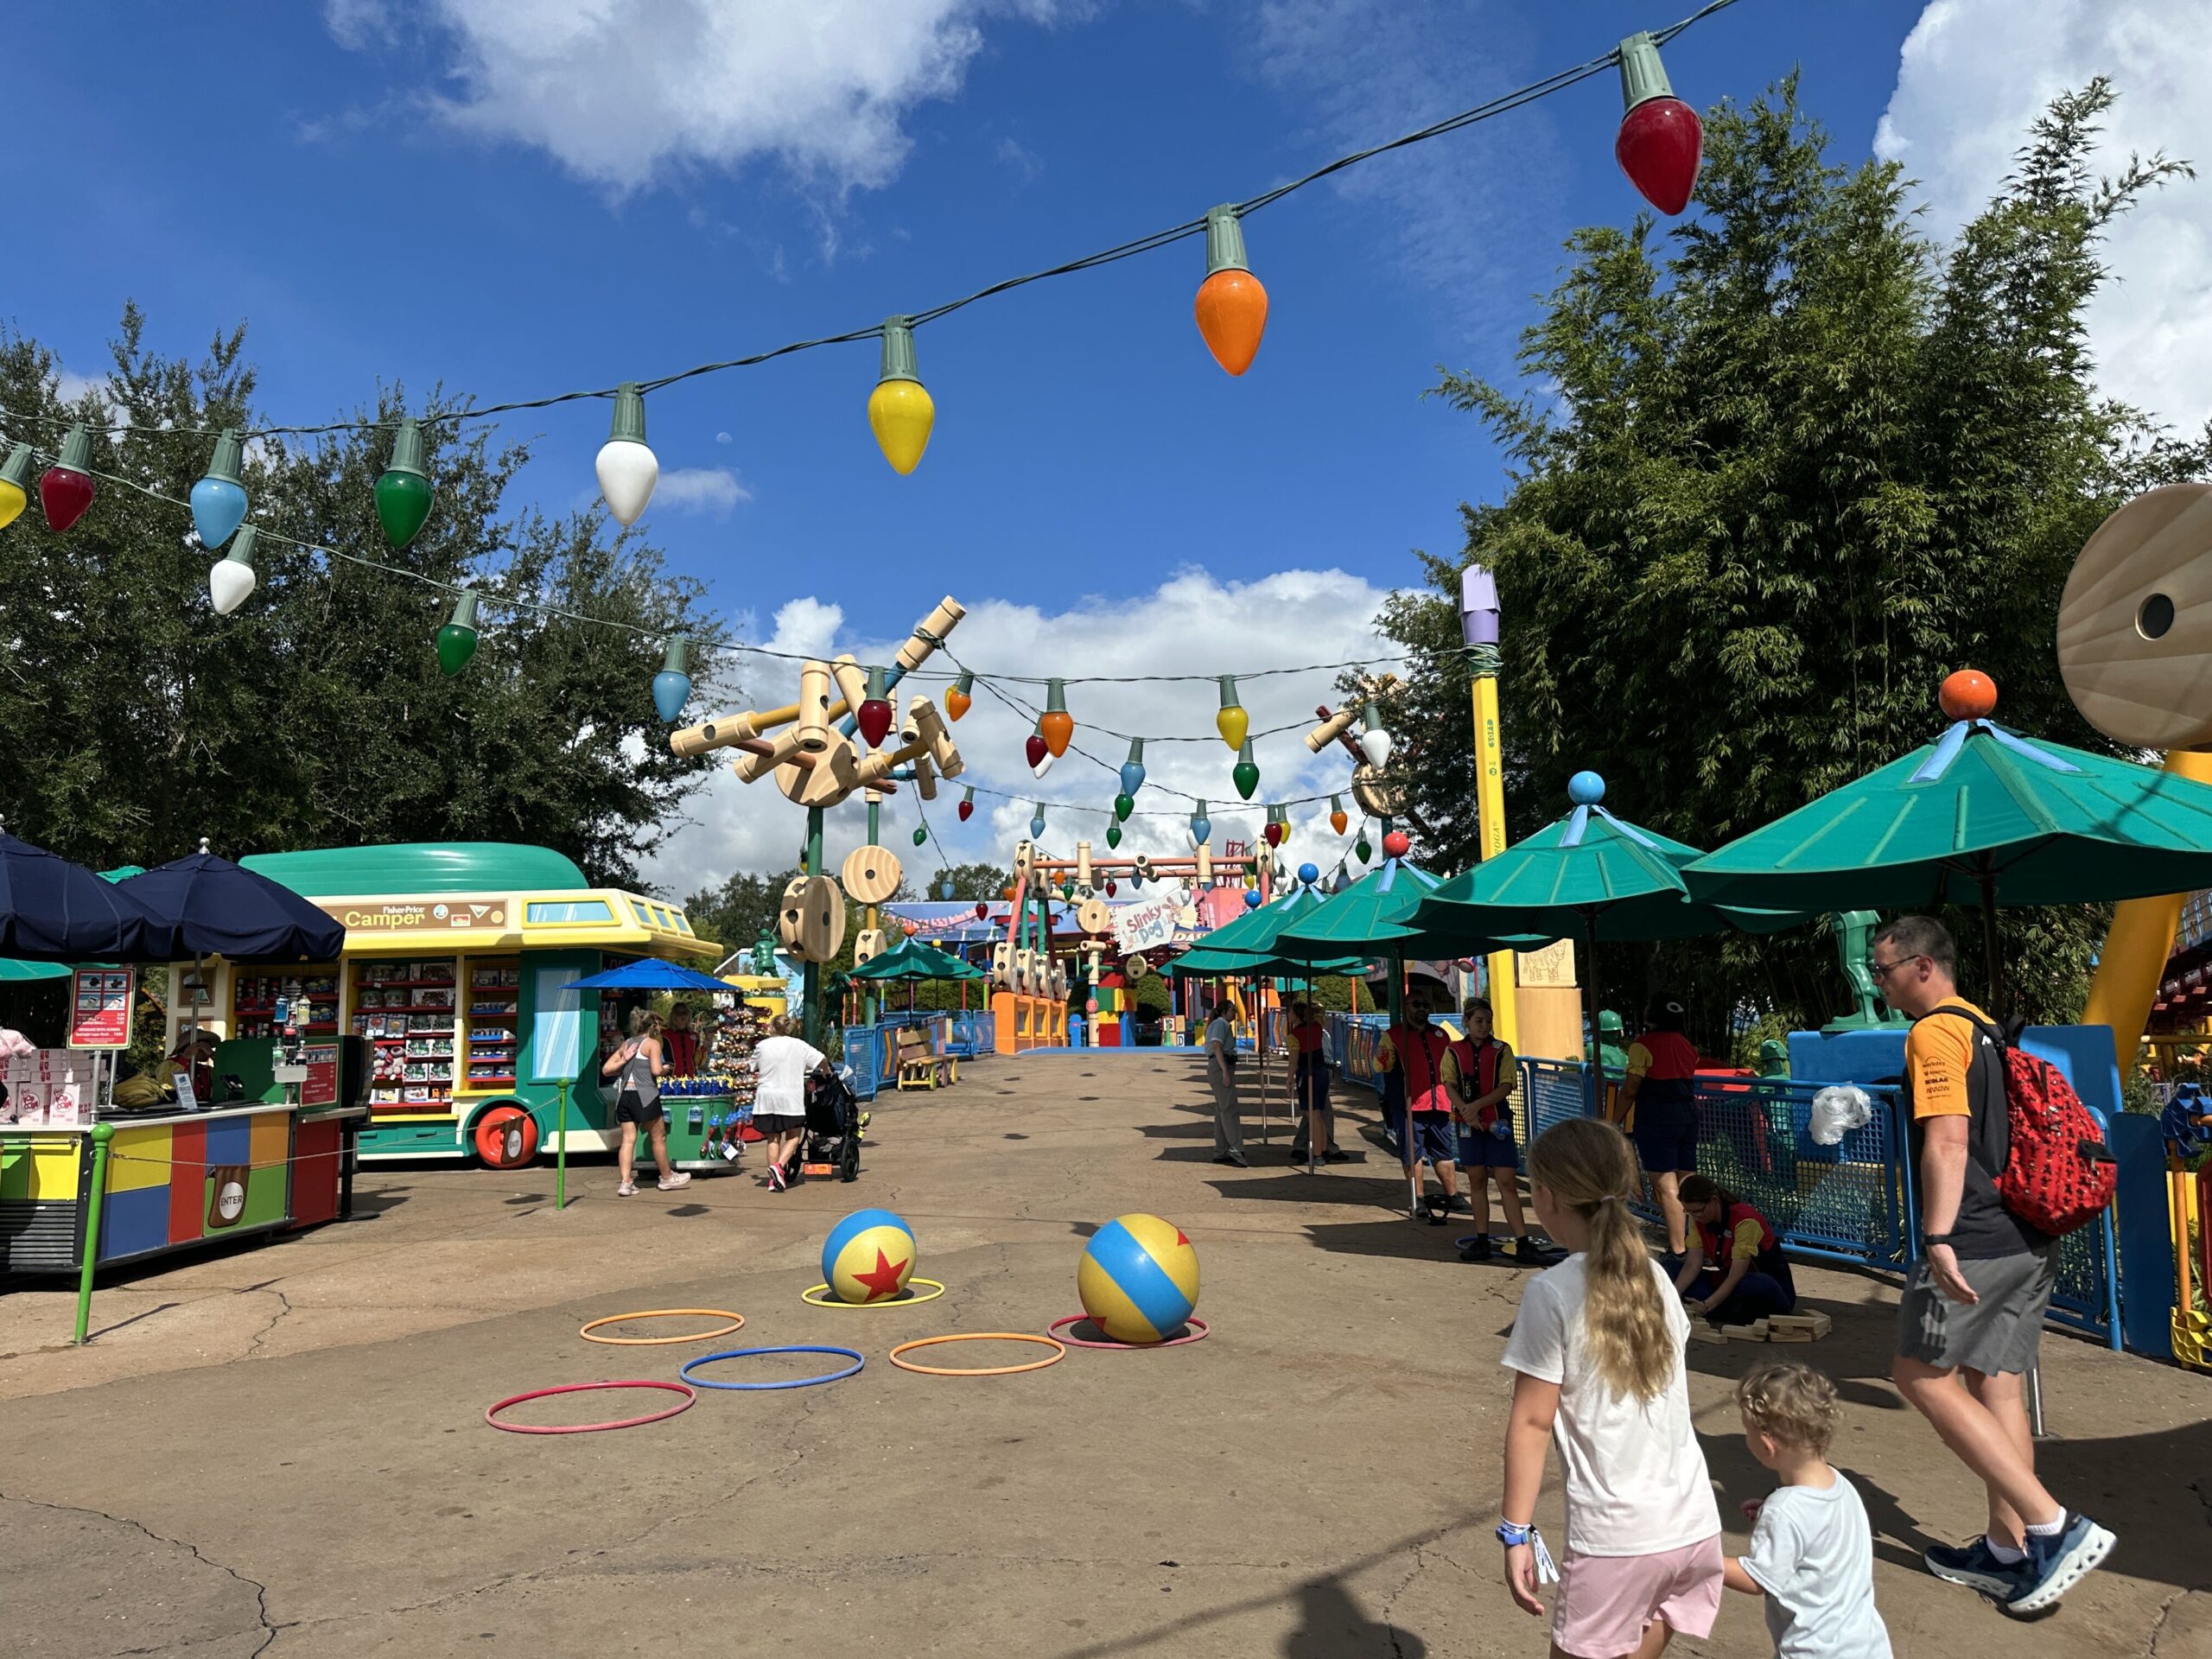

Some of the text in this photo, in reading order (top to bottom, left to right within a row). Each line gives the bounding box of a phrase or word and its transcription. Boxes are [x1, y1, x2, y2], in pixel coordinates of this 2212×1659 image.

[383, 906, 424, 914] Fisher-Price
[345, 911, 425, 929] Camper
[1126, 905, 1162, 933] Slinky
[1139, 919, 1165, 944] Dog
[1178, 1035, 1184, 1046] D
[220, 1194, 243, 1207] ENTER
